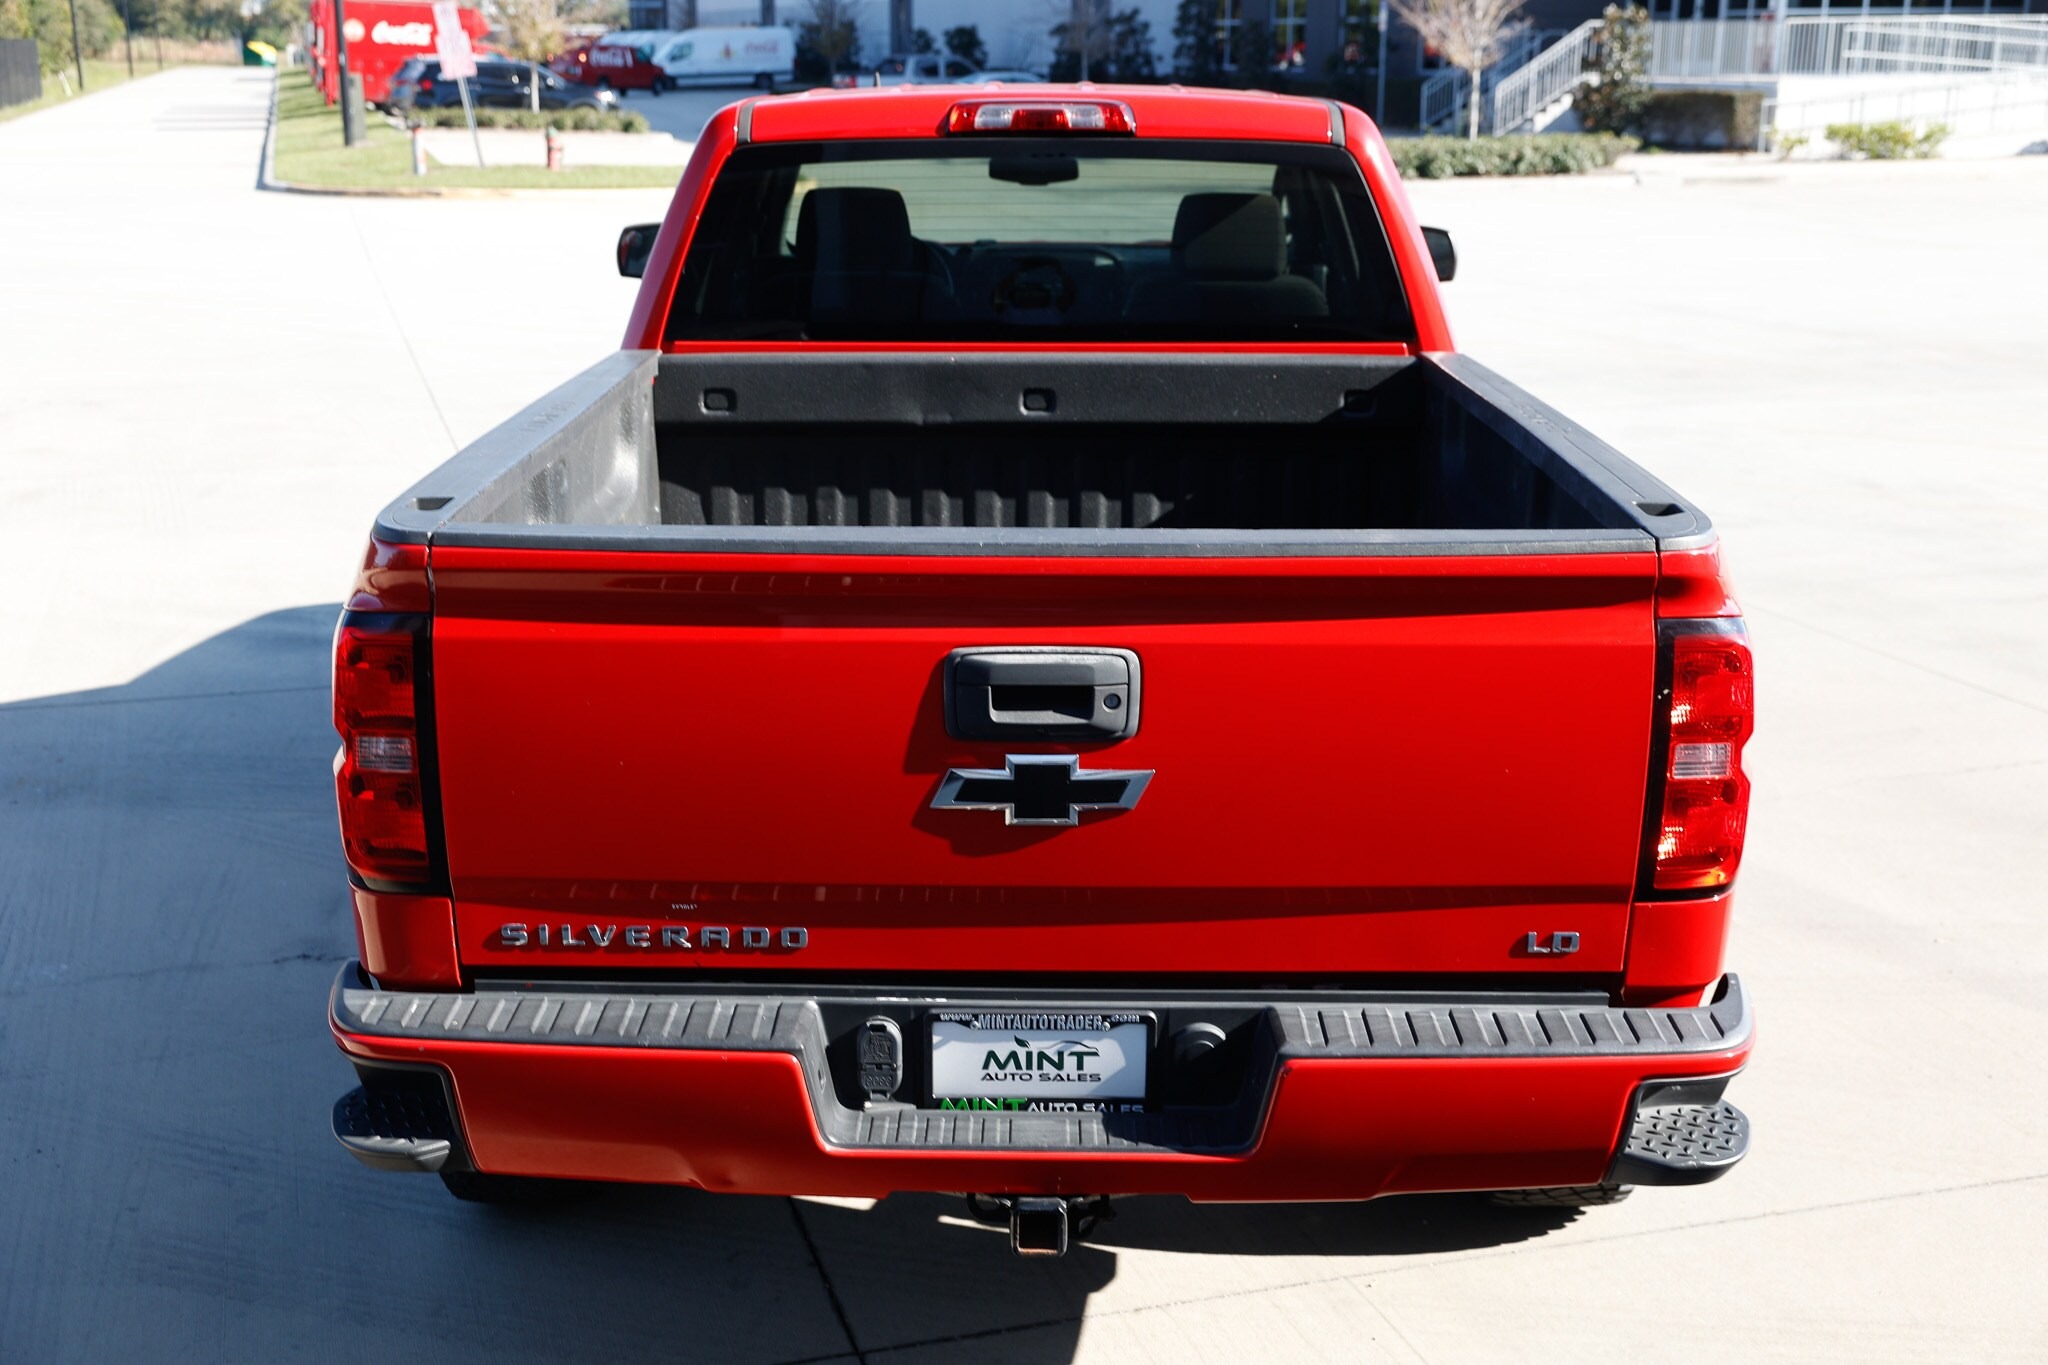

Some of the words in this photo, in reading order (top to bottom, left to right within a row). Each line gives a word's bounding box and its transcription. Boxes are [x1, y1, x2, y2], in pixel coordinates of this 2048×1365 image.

[501, 923, 809, 949] SILVERADO
[1527, 931, 1580, 953] LD
[981, 1050, 1100, 1071] MINT
[981, 1072, 1033, 1082] AUTO
[1039, 1072, 1101, 1082] SALES
[940, 1097, 1028, 1111] MINT
[1027, 1102, 1078, 1113] AUTO
